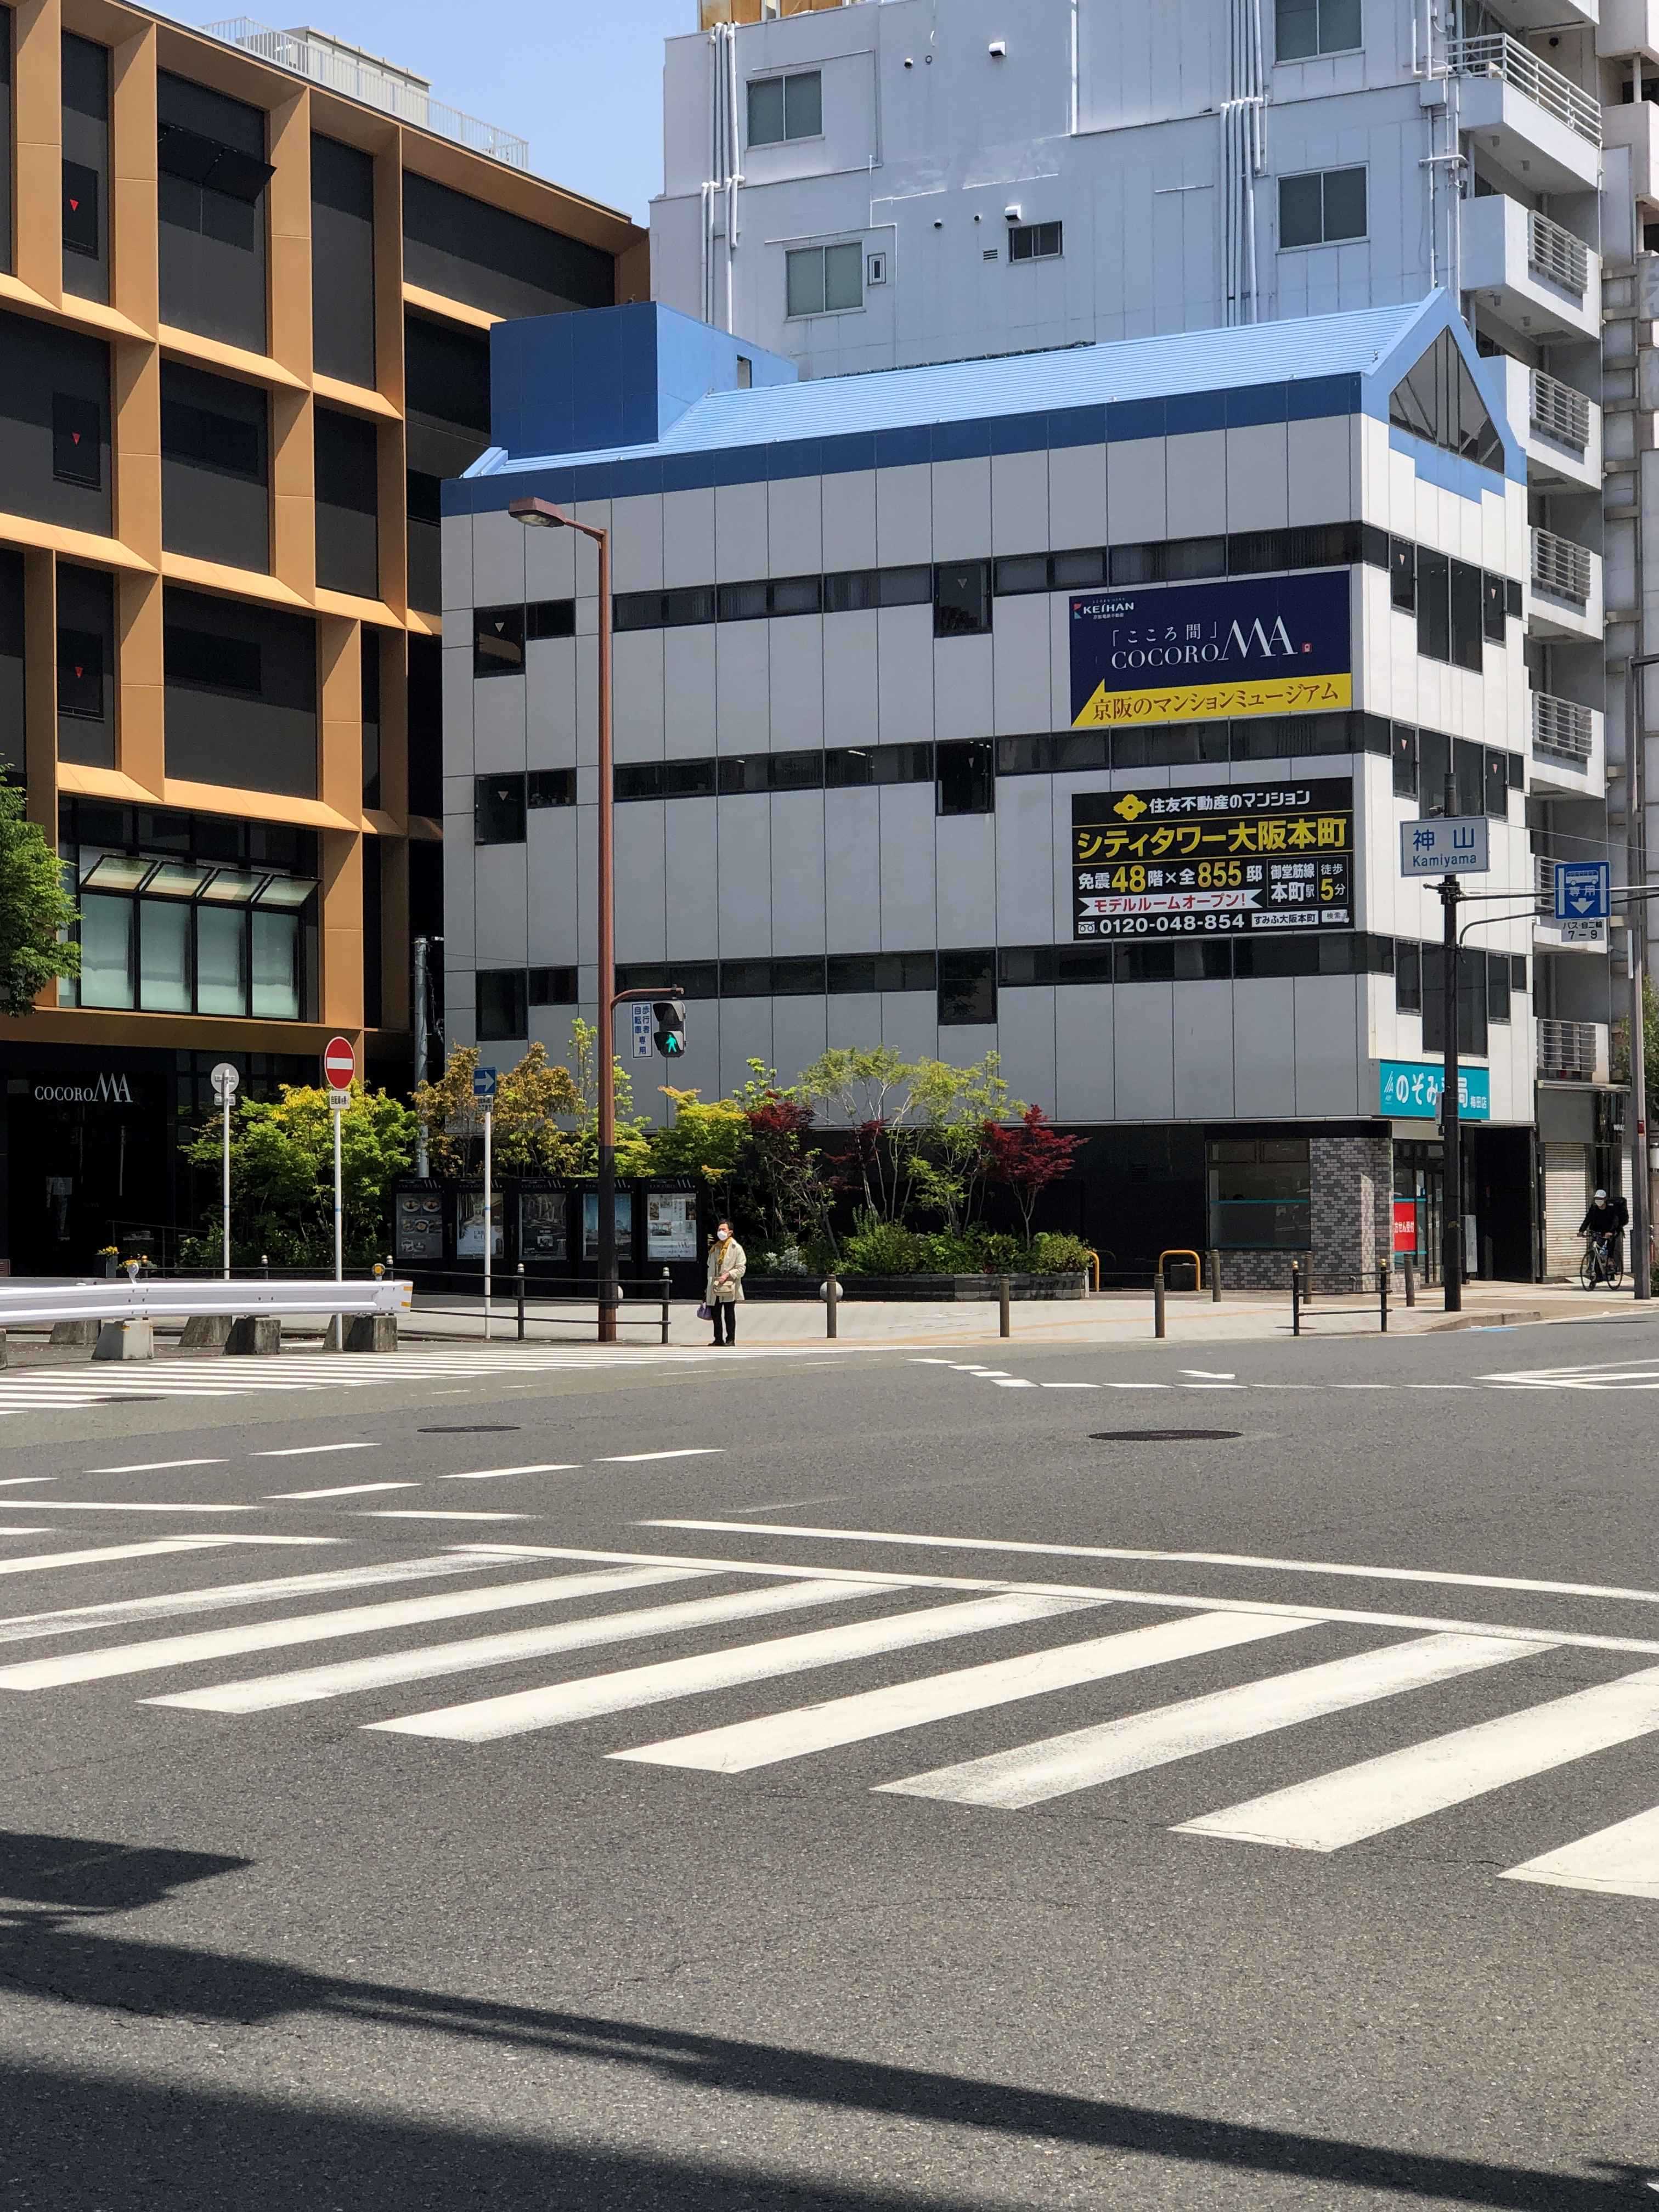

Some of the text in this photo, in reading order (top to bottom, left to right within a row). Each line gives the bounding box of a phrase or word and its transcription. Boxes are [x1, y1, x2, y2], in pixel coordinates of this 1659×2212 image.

[1084, 602, 1134, 614] KEIHAN
[1092, 682, 1339, 721] 京阪のマンションミュージアム
[1149, 790, 1310, 814] 住友不動産のマンション
[1077, 817, 1347, 860] シティタワー大阪本町
[1321, 864, 1344, 876] 徒歩
[1413, 853, 1476, 868] Kamiyama
[1270, 863, 1315, 880] 御堂筋線
[1270, 882, 1315, 903] 本町駅
[1321, 878, 1346, 901] 5分
[1094, 893, 1245, 913] モデルルームオープン!
[1099, 913, 1245, 934] 0120-048-854
[1254, 913, 1316, 925] すみふ大阪本町
[1396, 1072, 1468, 1108] のぞみ局
